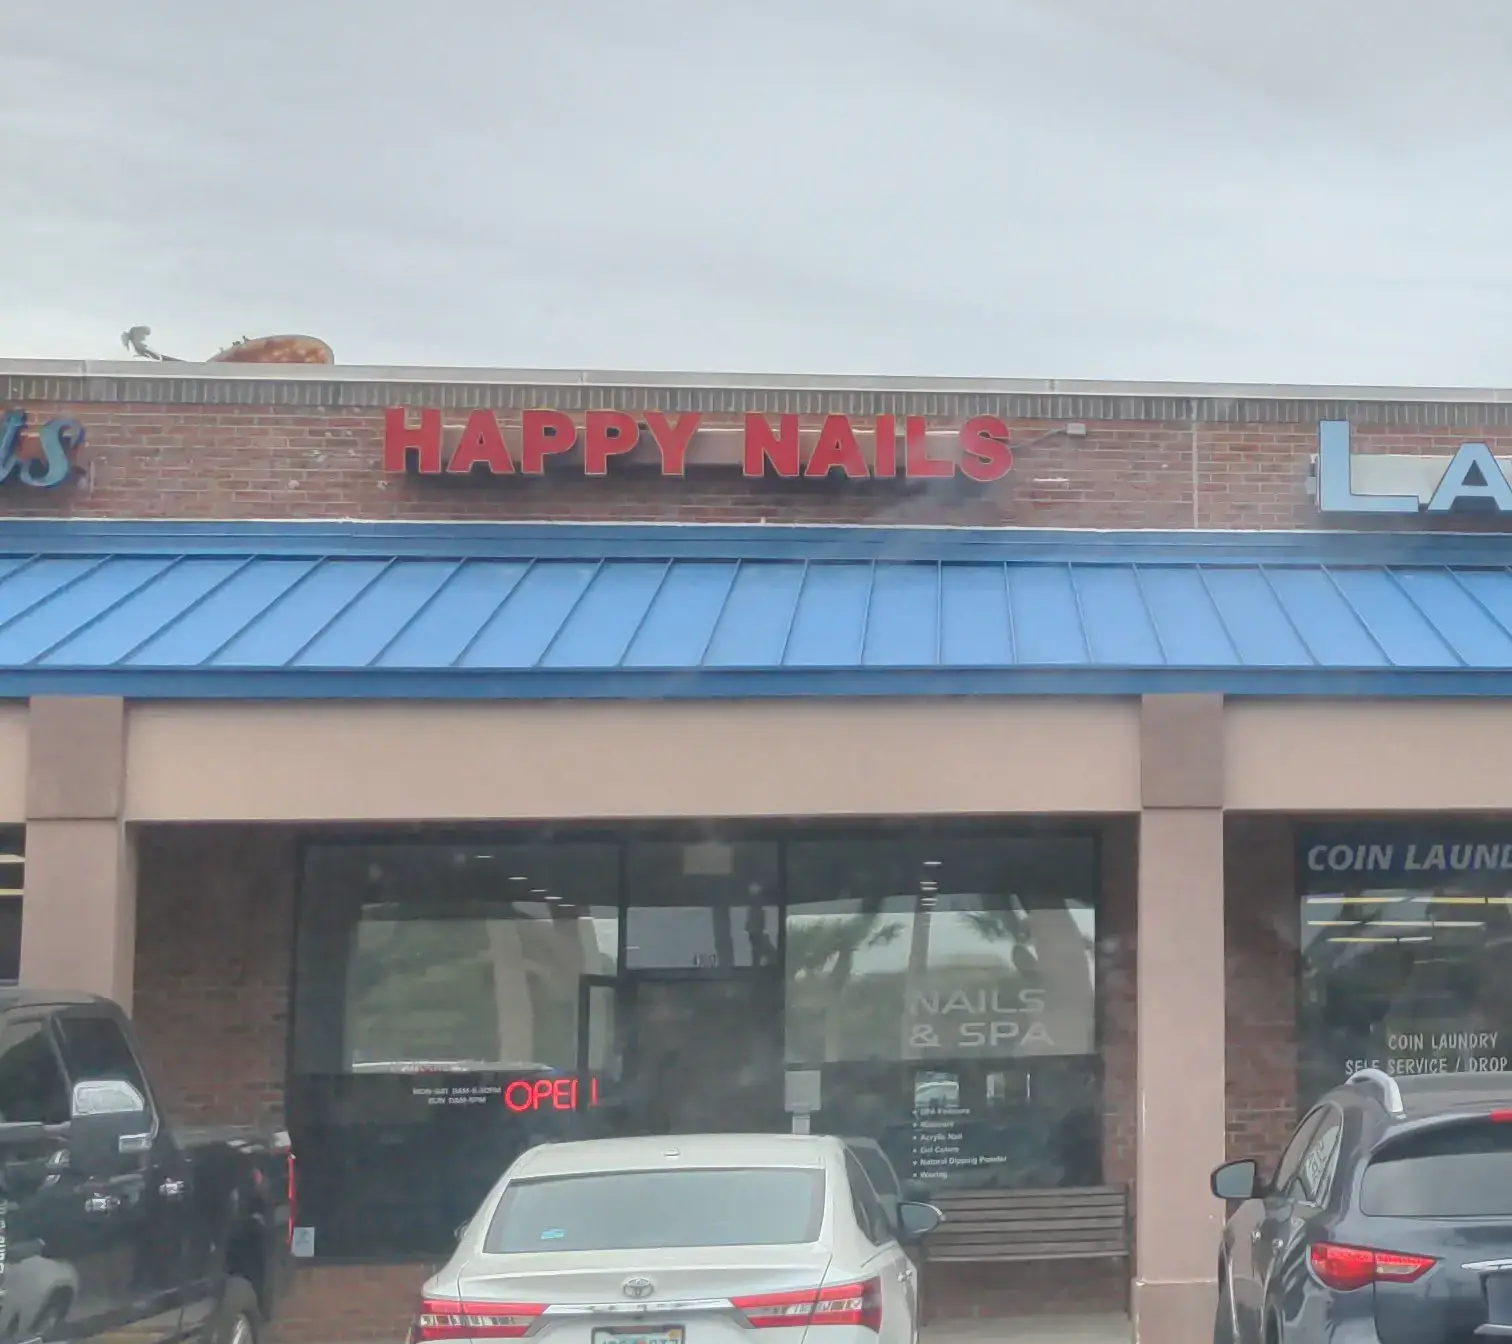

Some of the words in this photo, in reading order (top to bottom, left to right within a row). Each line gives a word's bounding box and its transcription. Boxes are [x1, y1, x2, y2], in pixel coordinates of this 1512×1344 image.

[384, 407, 701, 476] HAPPY
[743, 412, 1013, 482] NAILS
[1307, 844, 1394, 870] COIN
[908, 988, 1046, 1015] NAILS
[909, 1024, 941, 1047] &
[958, 1021, 1056, 1047] SPA
[1388, 1033, 1424, 1051] COIN
[1431, 1032, 1499, 1050] LAUNDRY
[1388, 1058, 1448, 1075] SERVICE
[1469, 1057, 1508, 1073] DROP
